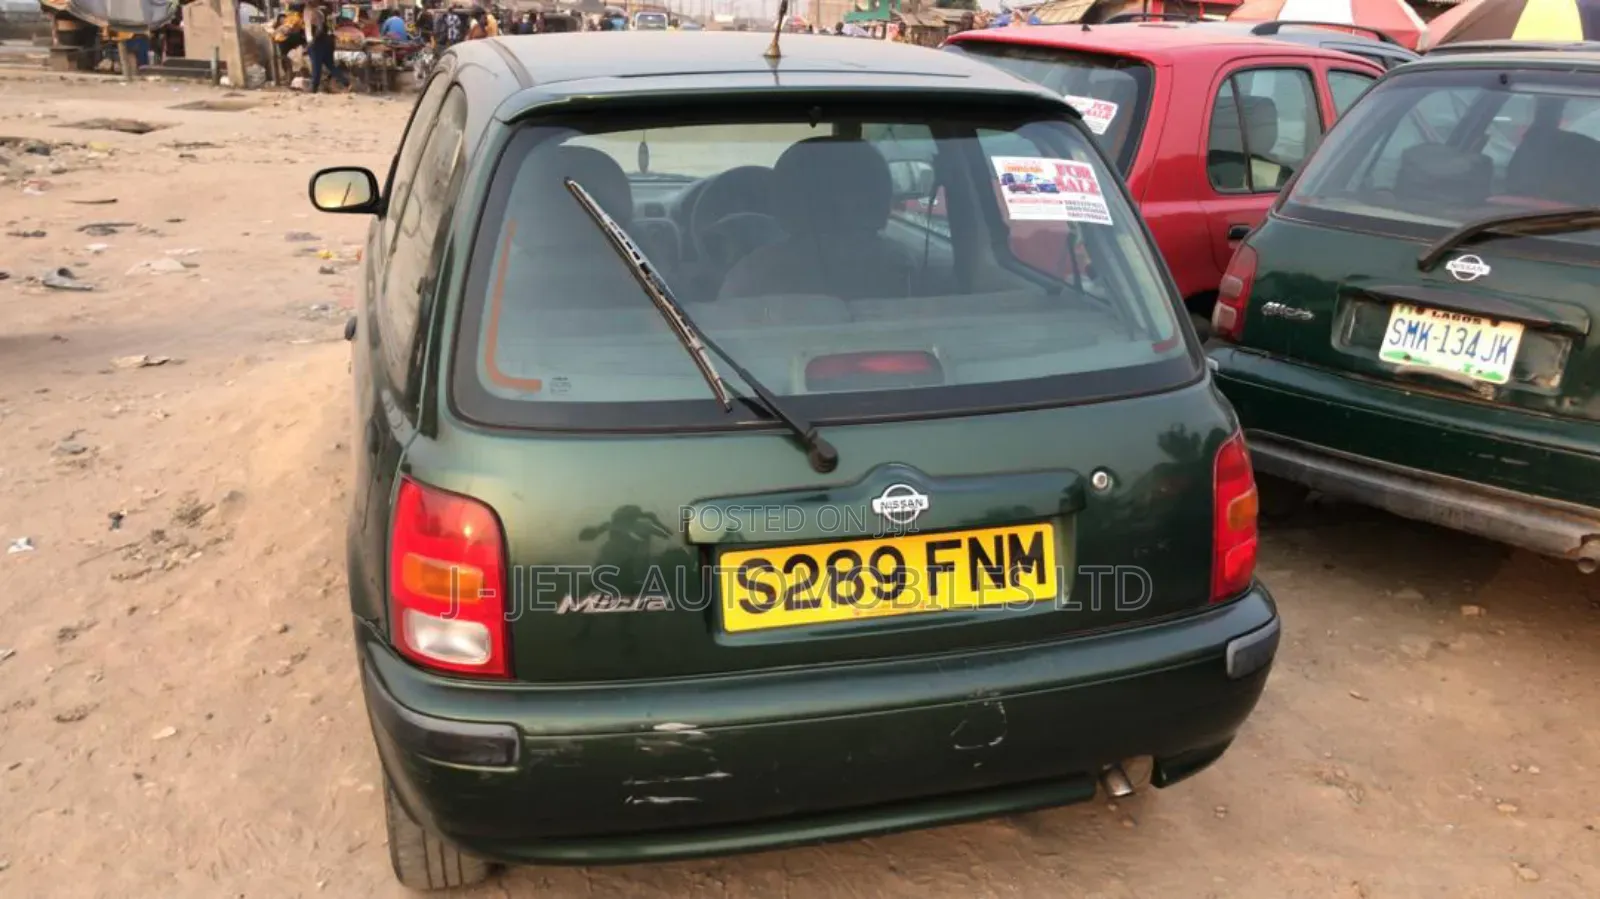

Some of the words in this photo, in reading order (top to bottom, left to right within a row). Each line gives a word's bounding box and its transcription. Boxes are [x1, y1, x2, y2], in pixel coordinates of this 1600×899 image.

[1053, 163, 1091, 178] FOR
[1053, 176, 1100, 195] SALE
[1431, 310, 1482, 325] LAGOS
[737, 545, 906, 614] S289
[925, 531, 1047, 597] FNM
